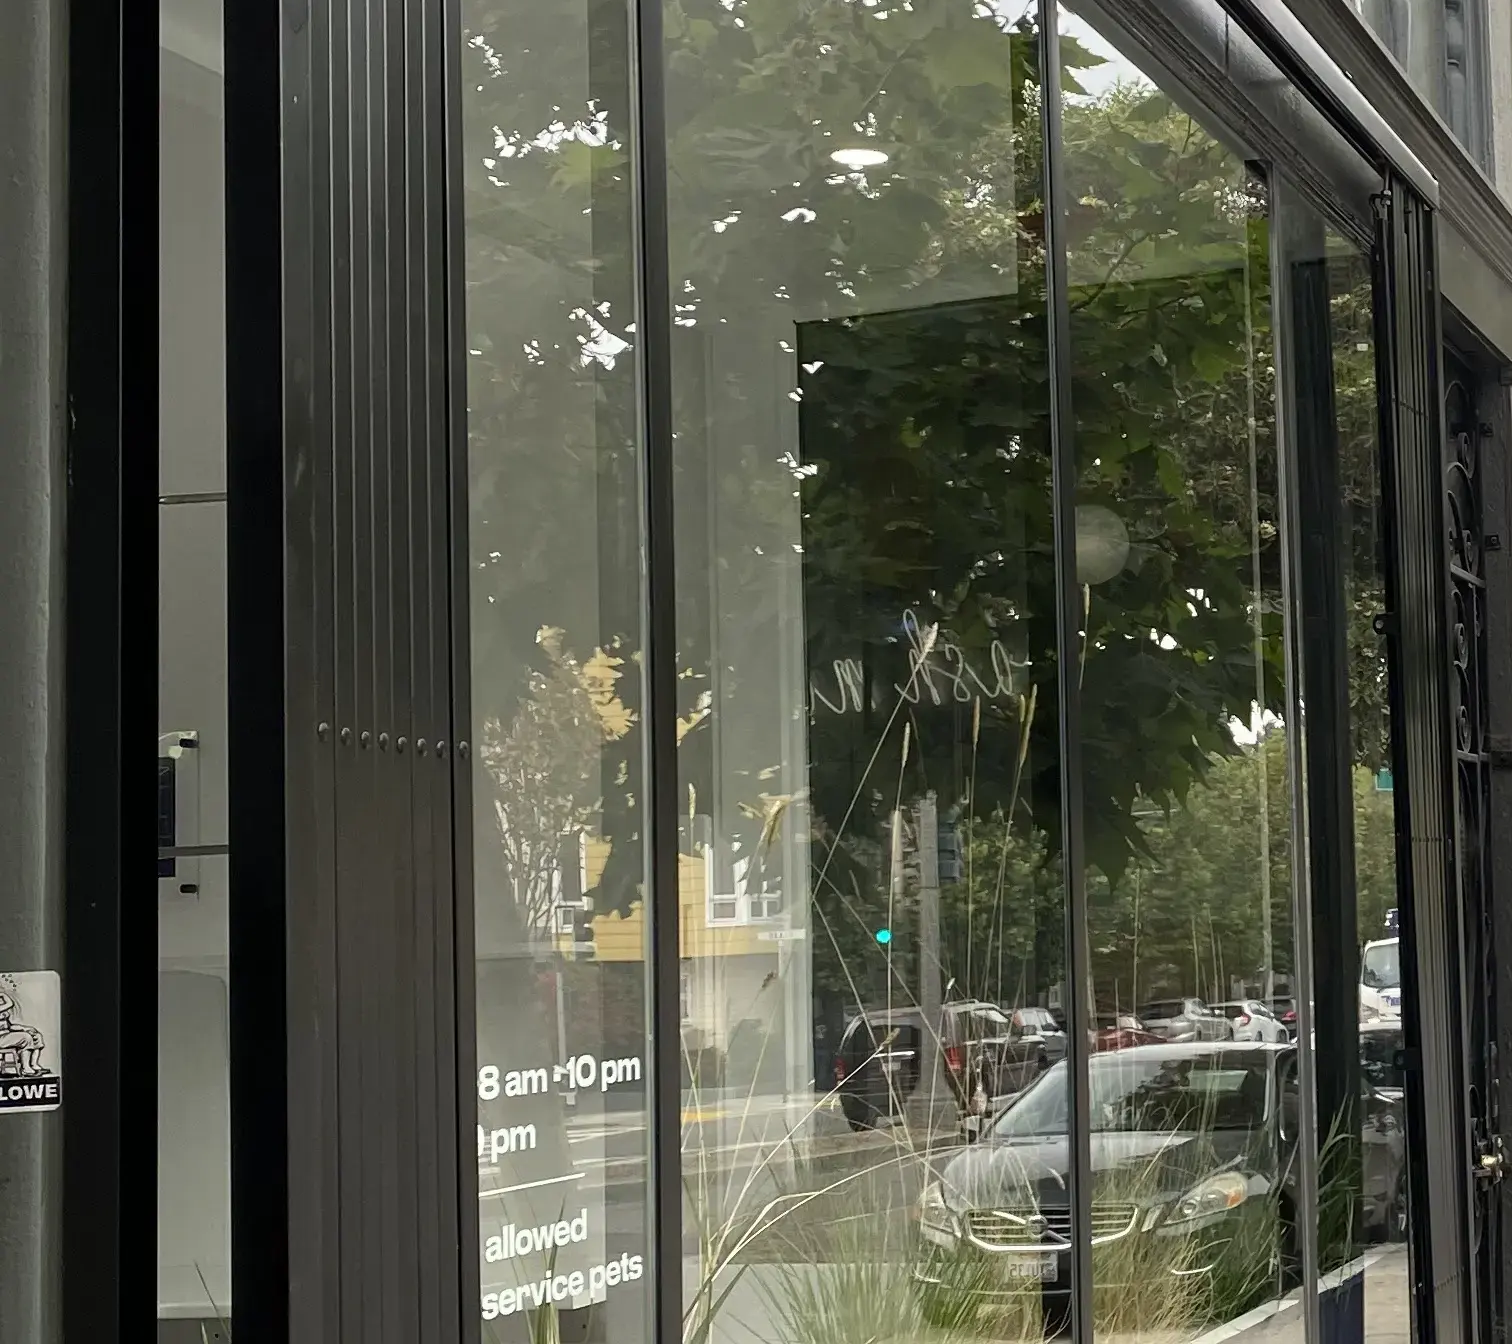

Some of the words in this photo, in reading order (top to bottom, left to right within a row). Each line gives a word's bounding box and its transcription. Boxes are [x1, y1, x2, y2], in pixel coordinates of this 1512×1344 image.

[478, 1065, 500, 1101] 8
[505, 1068, 548, 1097] am
[601, 1056, 641, 1092] pm
[491, 1123, 536, 1164] pm
[485, 1207, 588, 1263] allowed
[481, 1269, 585, 1321] service
[589, 1252, 643, 1299] pets
